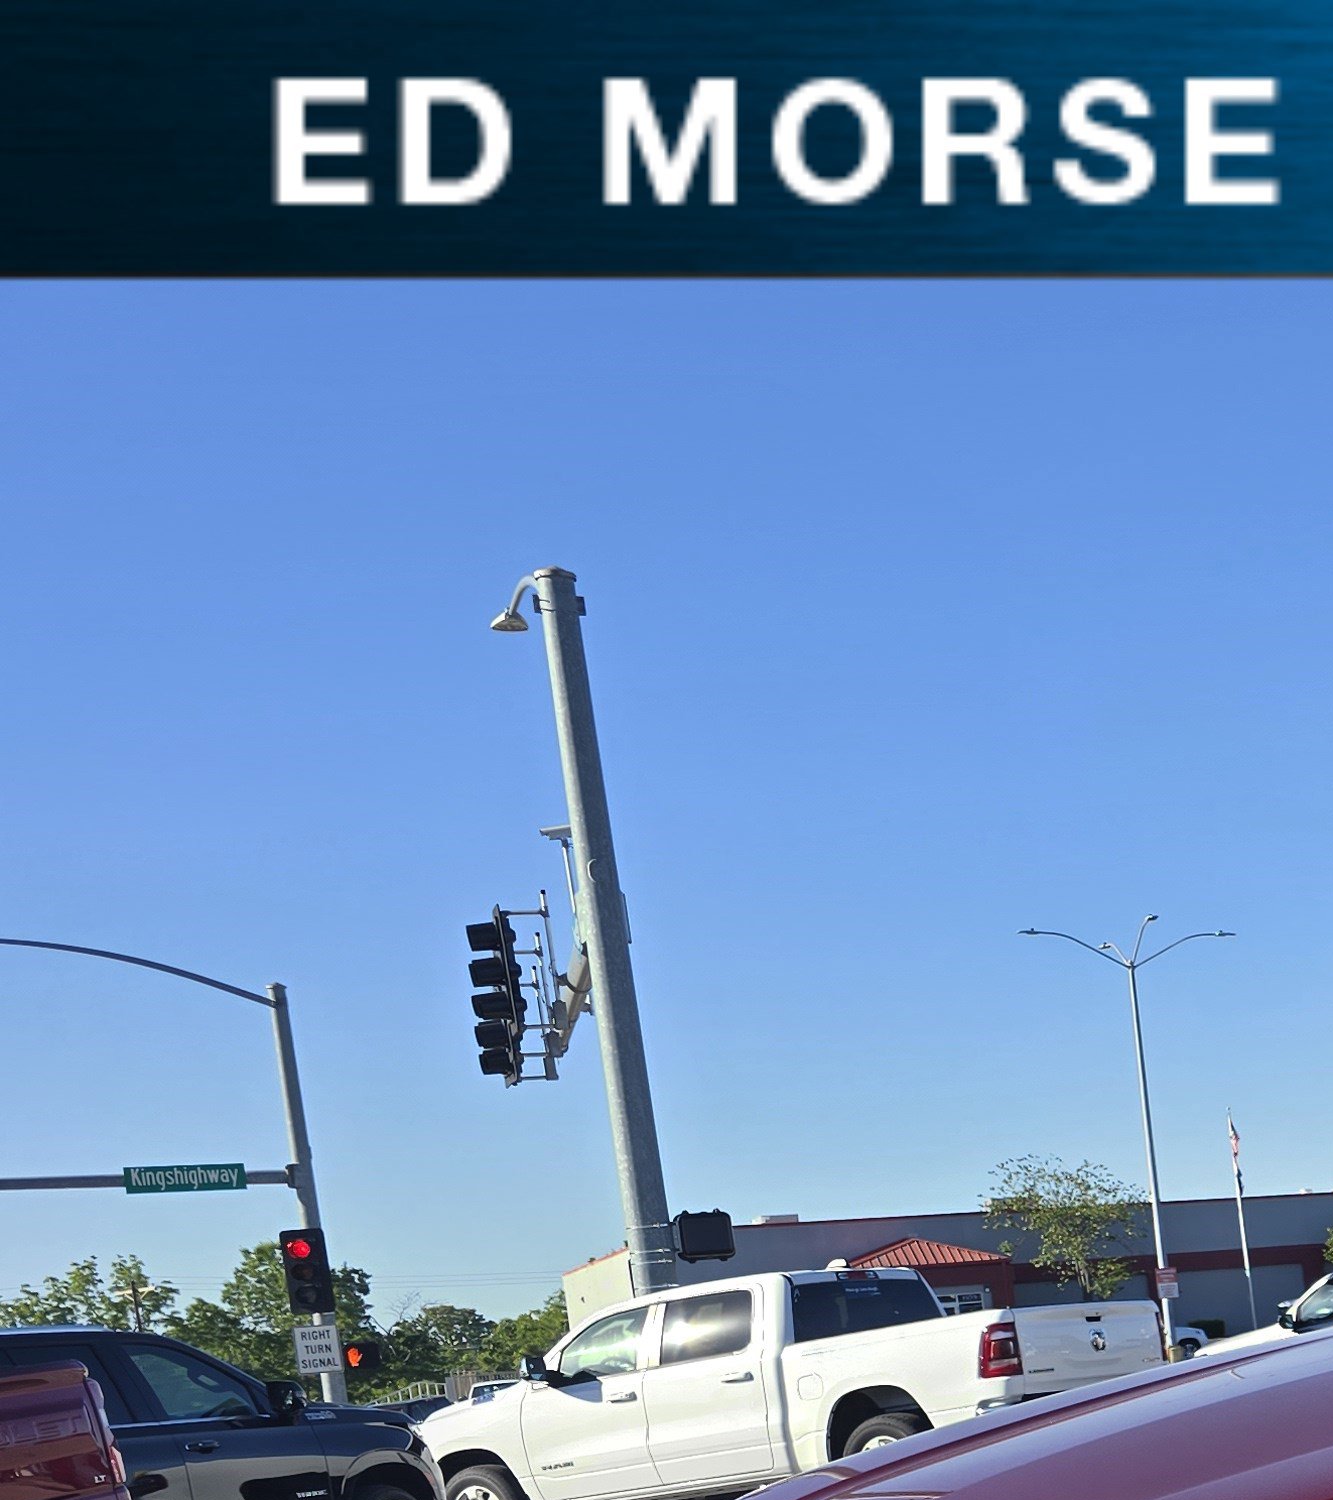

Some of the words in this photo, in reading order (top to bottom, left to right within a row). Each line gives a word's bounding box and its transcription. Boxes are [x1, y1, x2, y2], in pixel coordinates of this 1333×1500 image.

[130, 1167, 238, 1190] Kingshighway
[301, 1330, 330, 1341] RIGHT
[304, 1344, 332, 1354] TURN
[301, 1358, 339, 1369] SIGNAL
